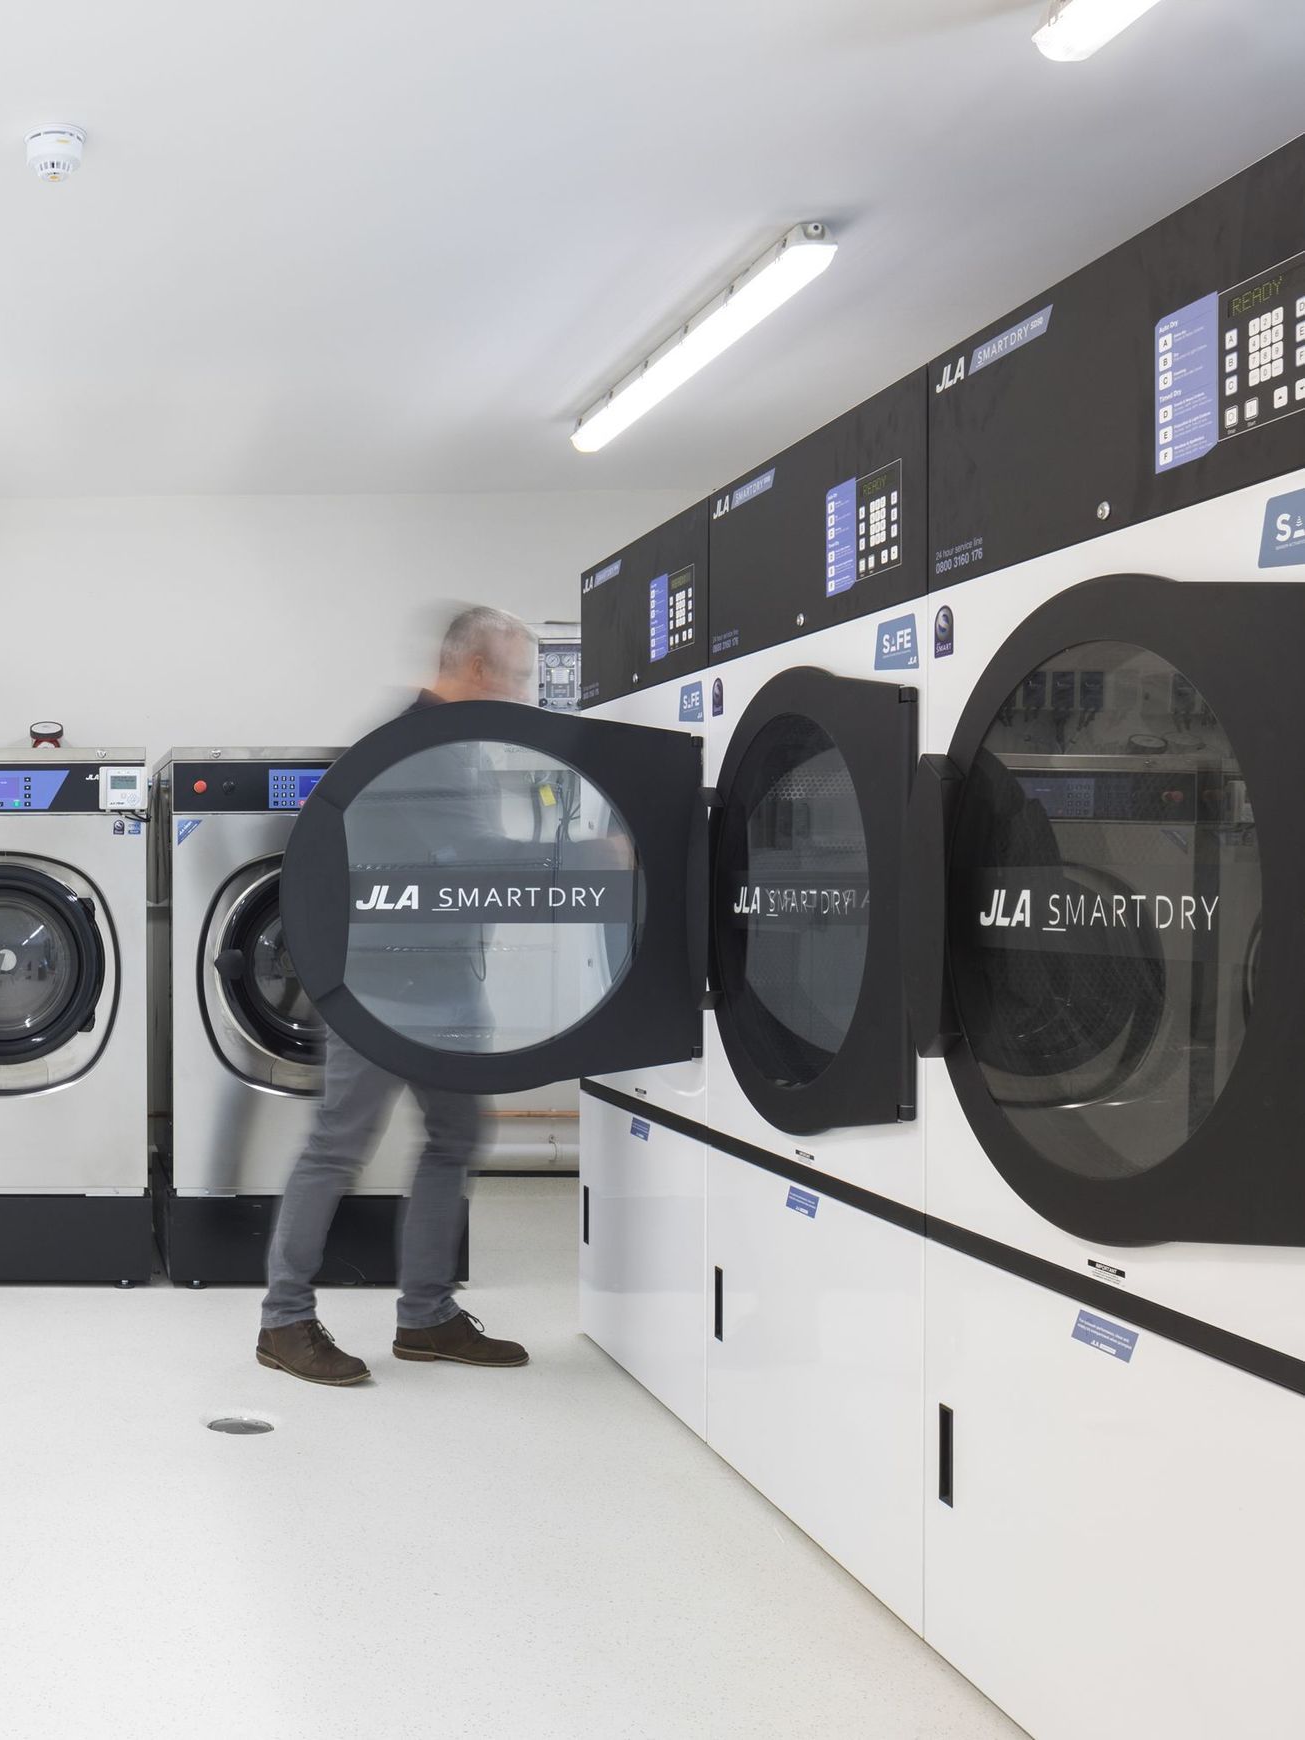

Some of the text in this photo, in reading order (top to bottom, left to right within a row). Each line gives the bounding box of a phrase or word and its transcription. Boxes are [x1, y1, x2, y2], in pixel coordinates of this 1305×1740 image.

[1232, 274, 1283, 316] READY
[936, 356, 965, 394] JLA
[976, 323, 1029, 367] SMARTDRY
[713, 494, 730, 519] JLA
[935, 559, 952, 574] 0800
[355, 885, 606, 910] JLA SMARTDRY
[734, 886, 850, 916] JLA SMARTDRY
[980, 889, 1219, 931] JLA SMARTDRY
